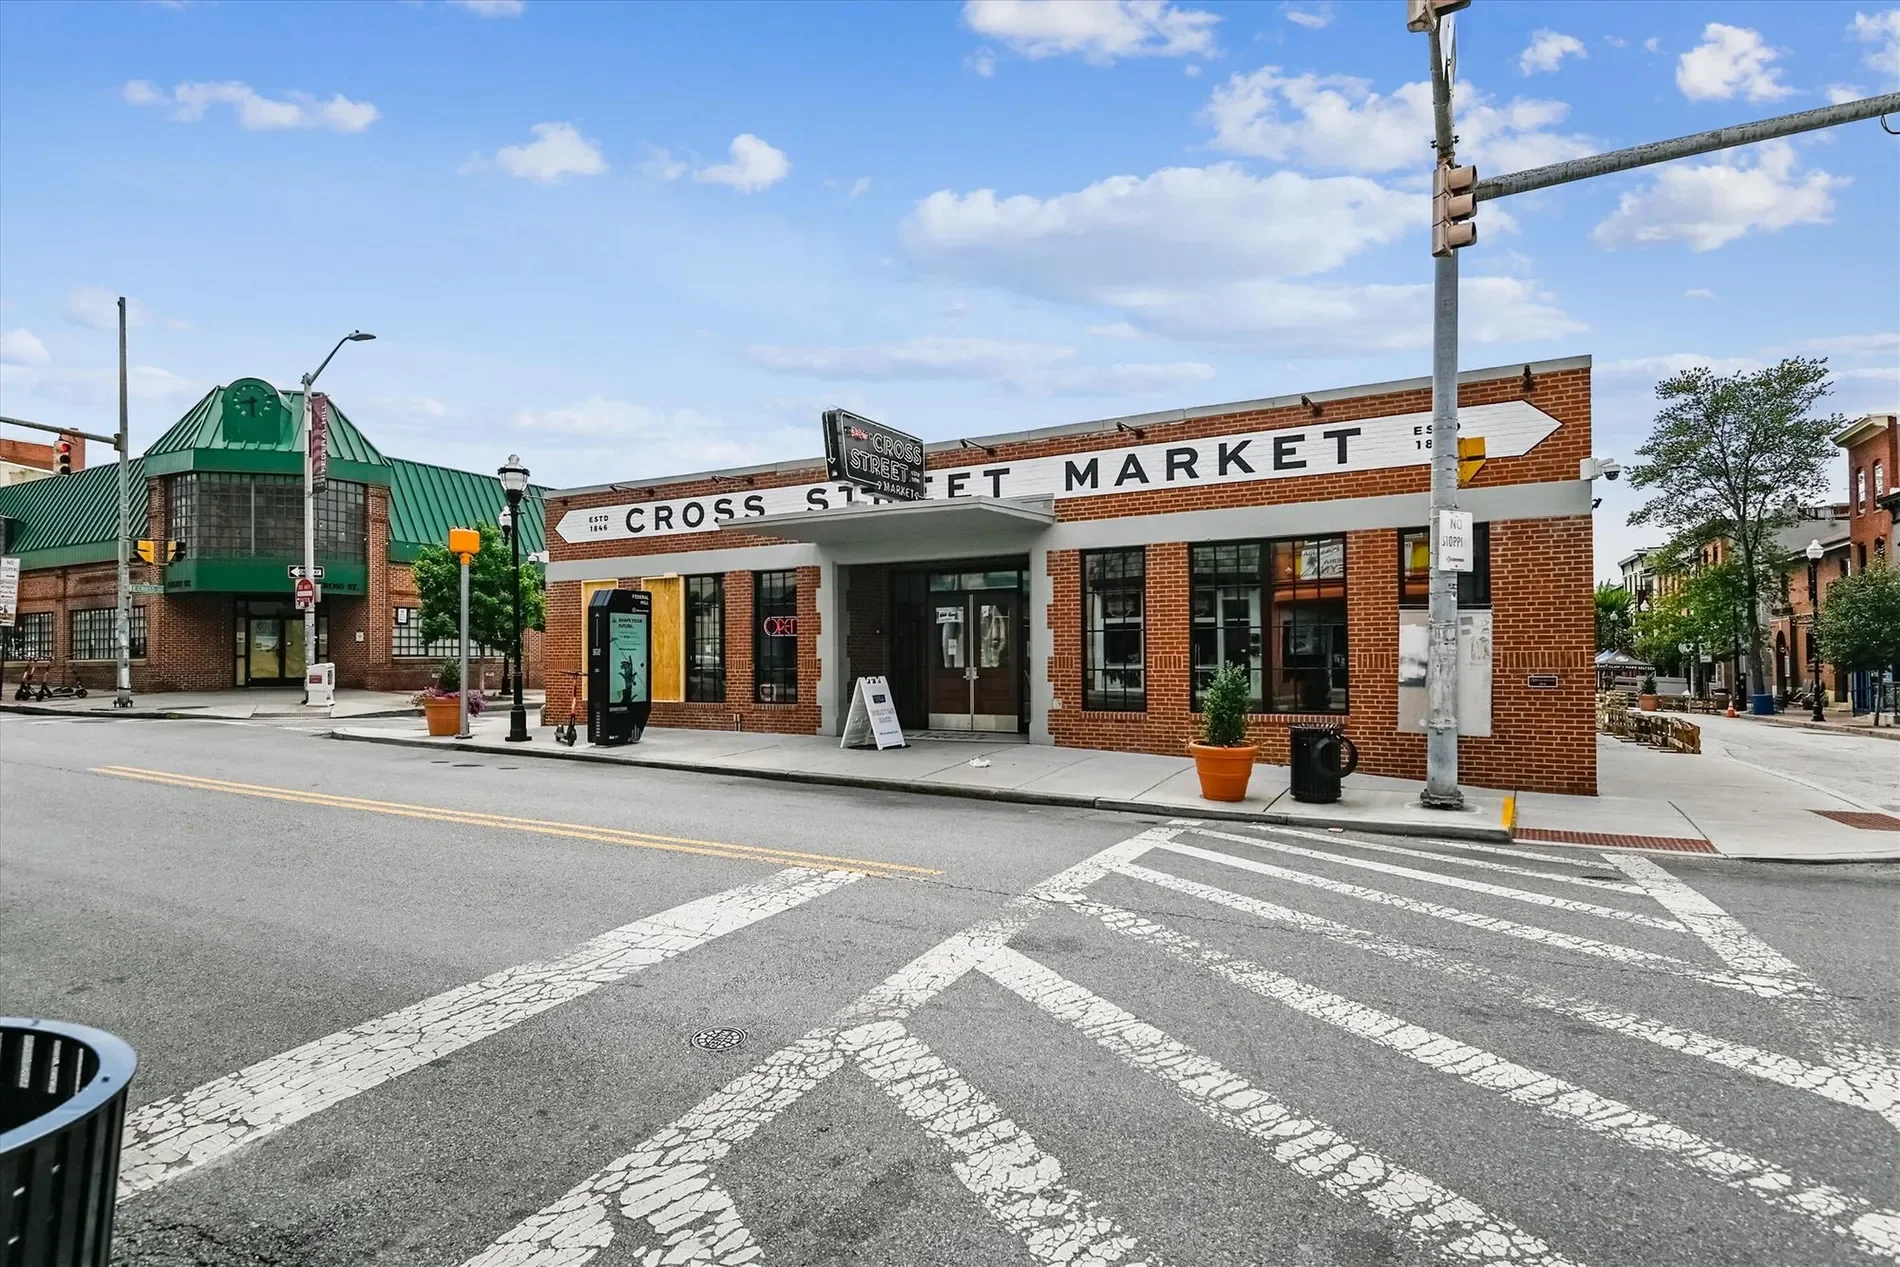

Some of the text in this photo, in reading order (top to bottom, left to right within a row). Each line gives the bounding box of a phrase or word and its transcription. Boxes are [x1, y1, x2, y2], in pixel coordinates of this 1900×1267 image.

[872, 433, 922, 466] CROSS
[850, 448, 908, 483] STREET
[625, 495, 766, 534] CROSS
[1065, 427, 1362, 492] MARKET
[883, 482, 916, 499] MARKET
[588, 515, 609, 523] ESTD
[1450, 519, 1463, 530] NO
